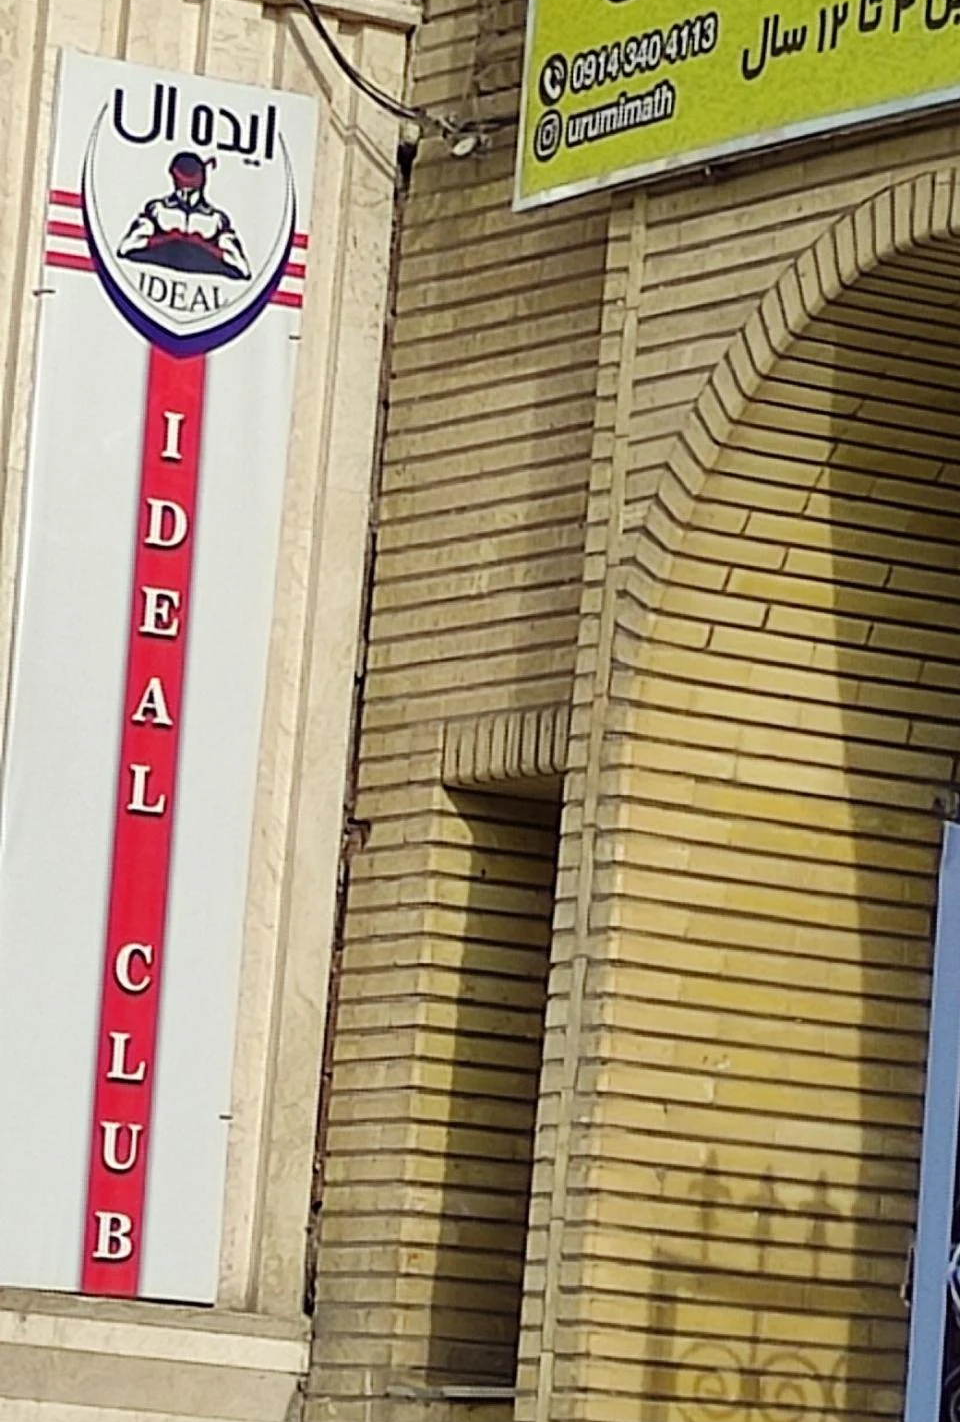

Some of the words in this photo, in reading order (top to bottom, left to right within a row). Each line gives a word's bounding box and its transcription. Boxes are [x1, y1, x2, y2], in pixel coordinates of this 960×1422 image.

[571, 44, 620, 91] 0914
[622, 34, 663, 80] 340
[664, 13, 717, 66] 4113
[742, 17, 807, 79] سال
[819, 3, 849, 53] ۱۲
[112, 83, 178, 144] ال
[190, 102, 278, 166] ایده
[566, 82, 675, 145] urumimath
[138, 272, 230, 313] IDEAL
[127, 409, 188, 817] IDEAL
[93, 941, 154, 1263] CLUB
